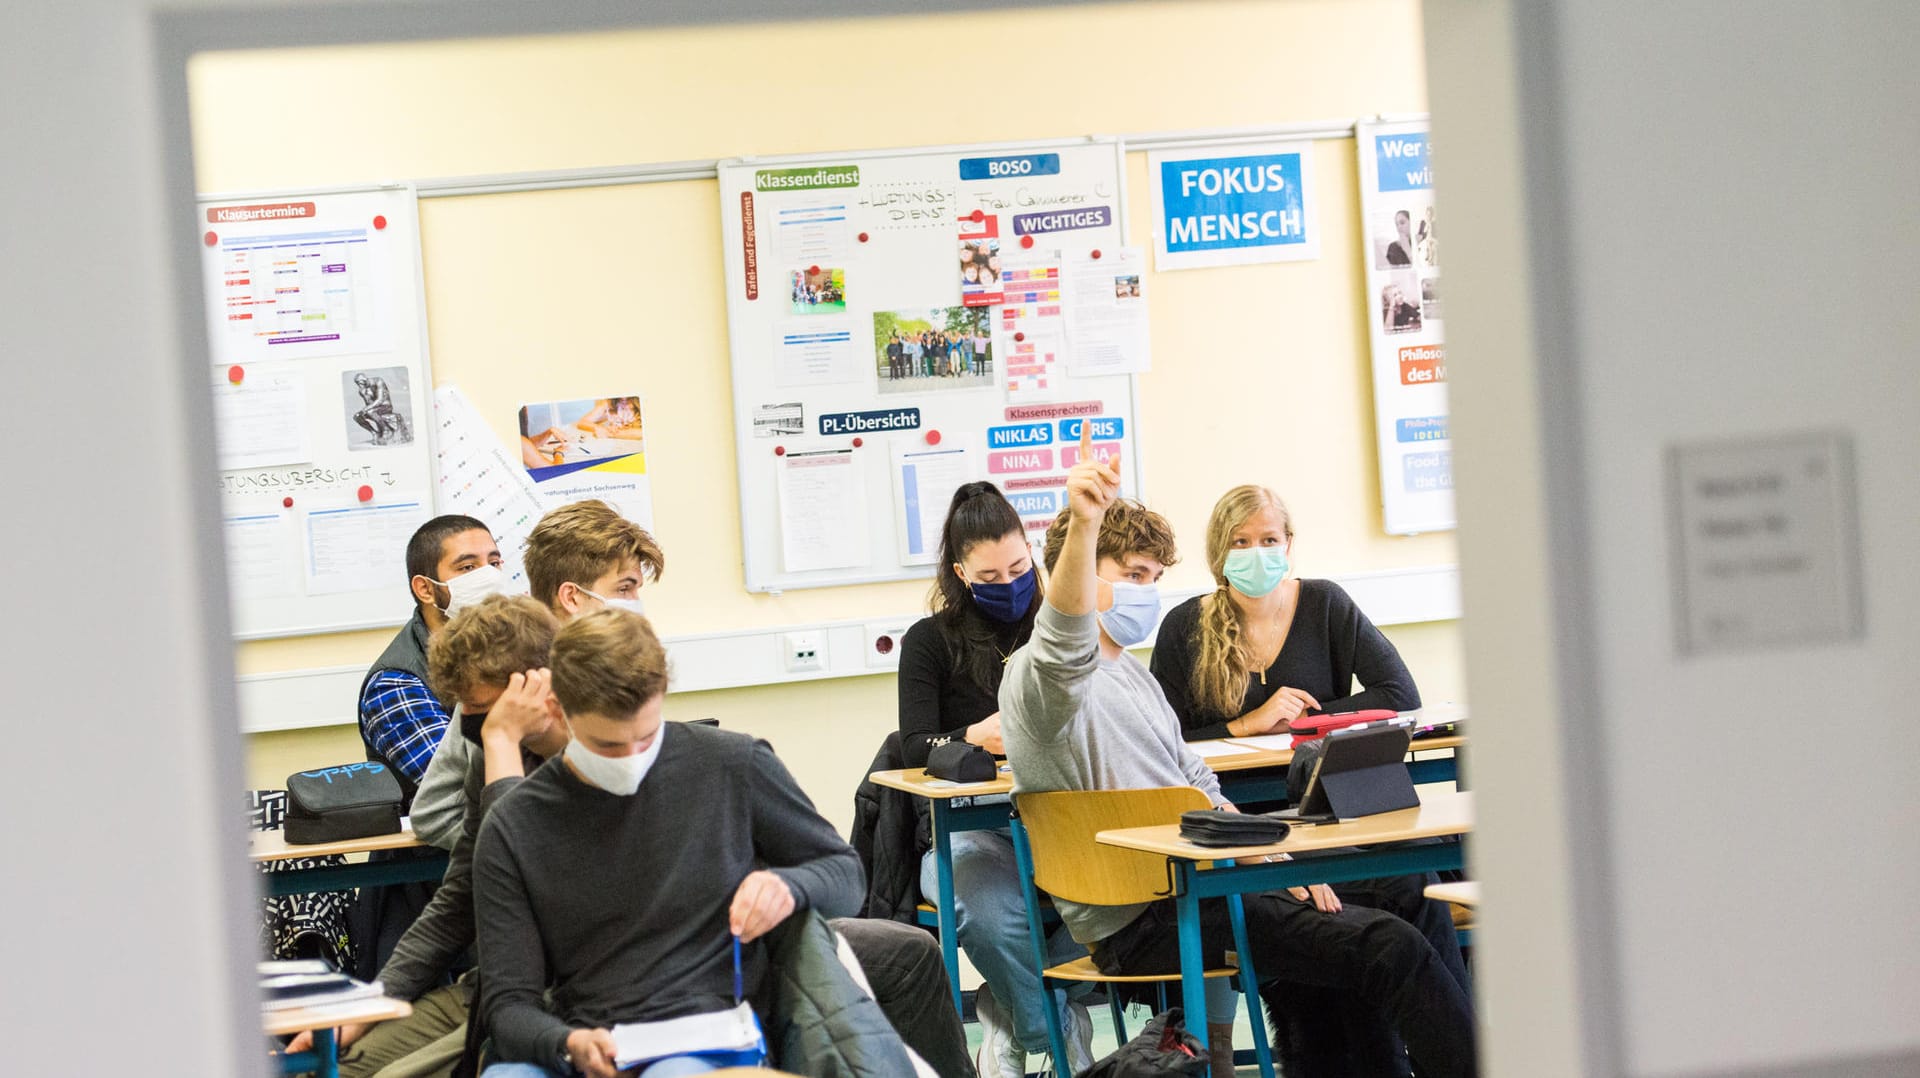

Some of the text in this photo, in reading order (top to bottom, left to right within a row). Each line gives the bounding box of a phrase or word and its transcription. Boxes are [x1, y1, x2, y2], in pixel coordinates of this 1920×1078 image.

[1382, 140, 1422, 158] Wer
[988, 160, 1032, 175] BOSO
[757, 170, 859, 188] Klassendienst
[1181, 164, 1285, 197] FOKUS
[217, 204, 306, 221] Klausurtermine
[888, 206, 945, 220] DIENST
[1020, 211, 1105, 232] WICHTIGES
[1170, 208, 1302, 244] MENSCH
[746, 248, 755, 267] und
[1407, 366, 1433, 382] des
[822, 412, 917, 433] PL-Übersicht
[994, 422, 1115, 445] NIKLAS CRIS
[1002, 448, 1109, 469] NINA LNA
